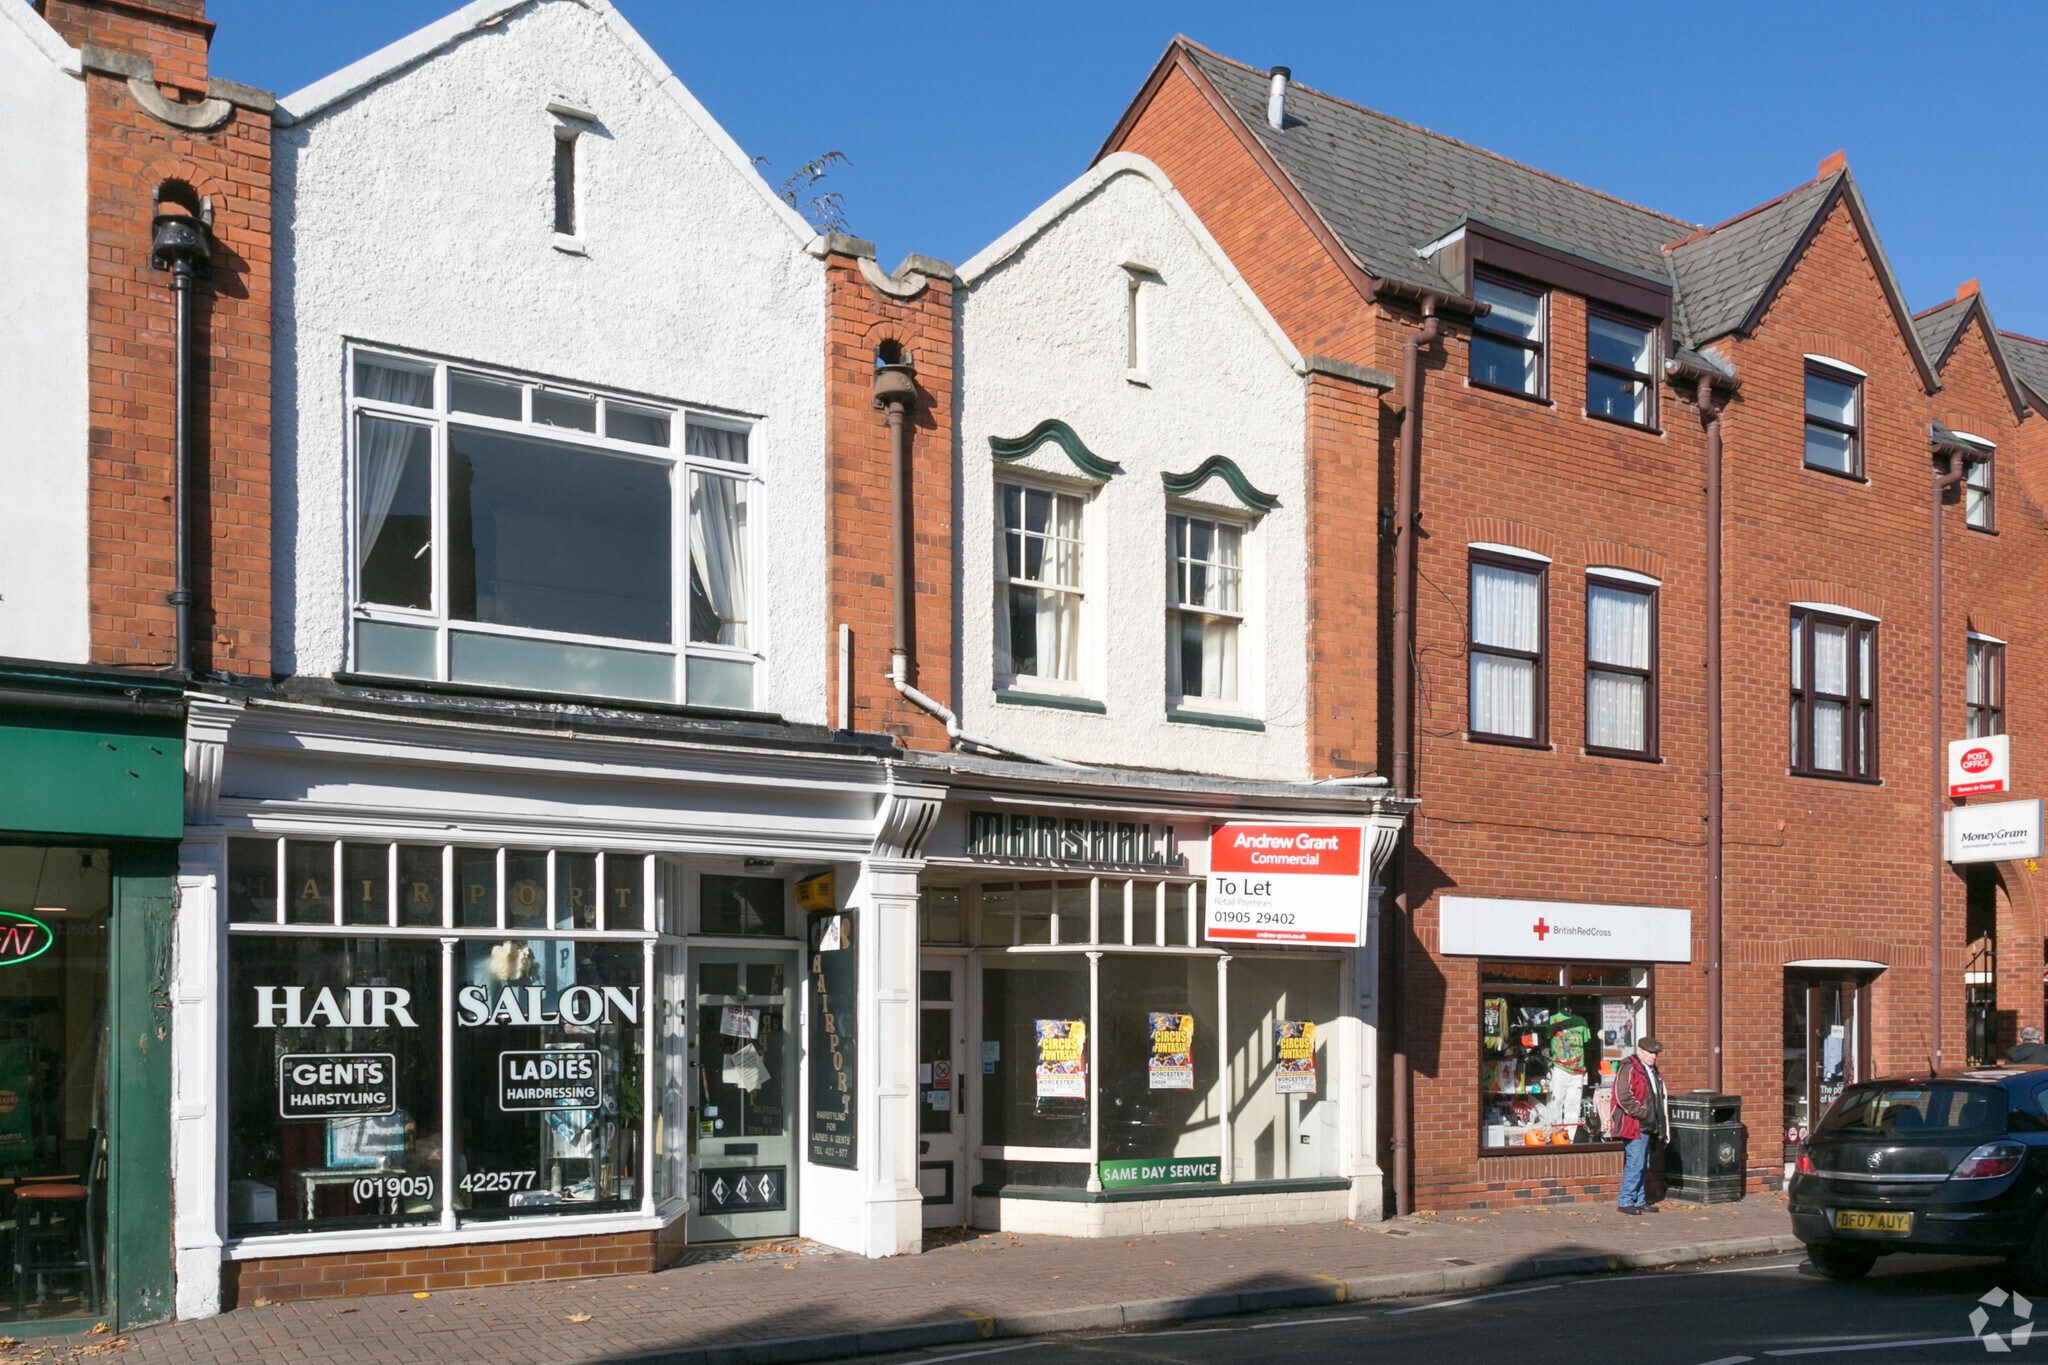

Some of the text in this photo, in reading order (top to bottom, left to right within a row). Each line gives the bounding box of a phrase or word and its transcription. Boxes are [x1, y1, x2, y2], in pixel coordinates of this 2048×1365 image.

[1967, 751, 1987, 760] POST
[1962, 759, 1990, 769] OFFICE
[967, 810, 1184, 867] MARSHALL
[1233, 831, 1339, 851] Andrew Grant
[1961, 829, 2028, 842] MoneyGram
[1251, 851, 1320, 866] Commercial
[1216, 878, 1272, 897] To Let
[1214, 897, 1273, 908] Retail Premises
[1214, 910, 1296, 926] 01905 29402
[1553, 925, 1612, 937] BritishRedCross
[253, 984, 640, 1028] HAIR SALON
[1154, 1030, 1187, 1042] CIRCUS
[1042, 1037, 1077, 1050] CIRCUS
[1153, 1042, 1187, 1053] FUNTASIA
[1280, 1037, 1310, 1049] CIRCUS
[1041, 1050, 1078, 1060] FUNTASIA
[1280, 1048, 1310, 1059] FUNTASIA
[292, 1062, 384, 1086] GENTS
[509, 1059, 593, 1081] LADIES
[507, 1086, 595, 1100] HAIRDRESSING
[1820, 1084, 1833, 1094] The
[290, 1091, 387, 1106] HAIRSTYLING
[1820, 1094, 1827, 1103] of
[816, 1110, 846, 1121] HAIRSTYLING
[1671, 1108, 1701, 1120] LITTER
[826, 1123, 837, 1132] FOR
[811, 1132, 850, 1146] LADIES & GENTS
[814, 1145, 823, 1155] TEL
[1104, 1163, 1217, 1181] SAME DAY SERVICE
[352, 1170, 537, 1204] (01905) 422577
[1841, 1213, 1904, 1229] DF07 AUY
